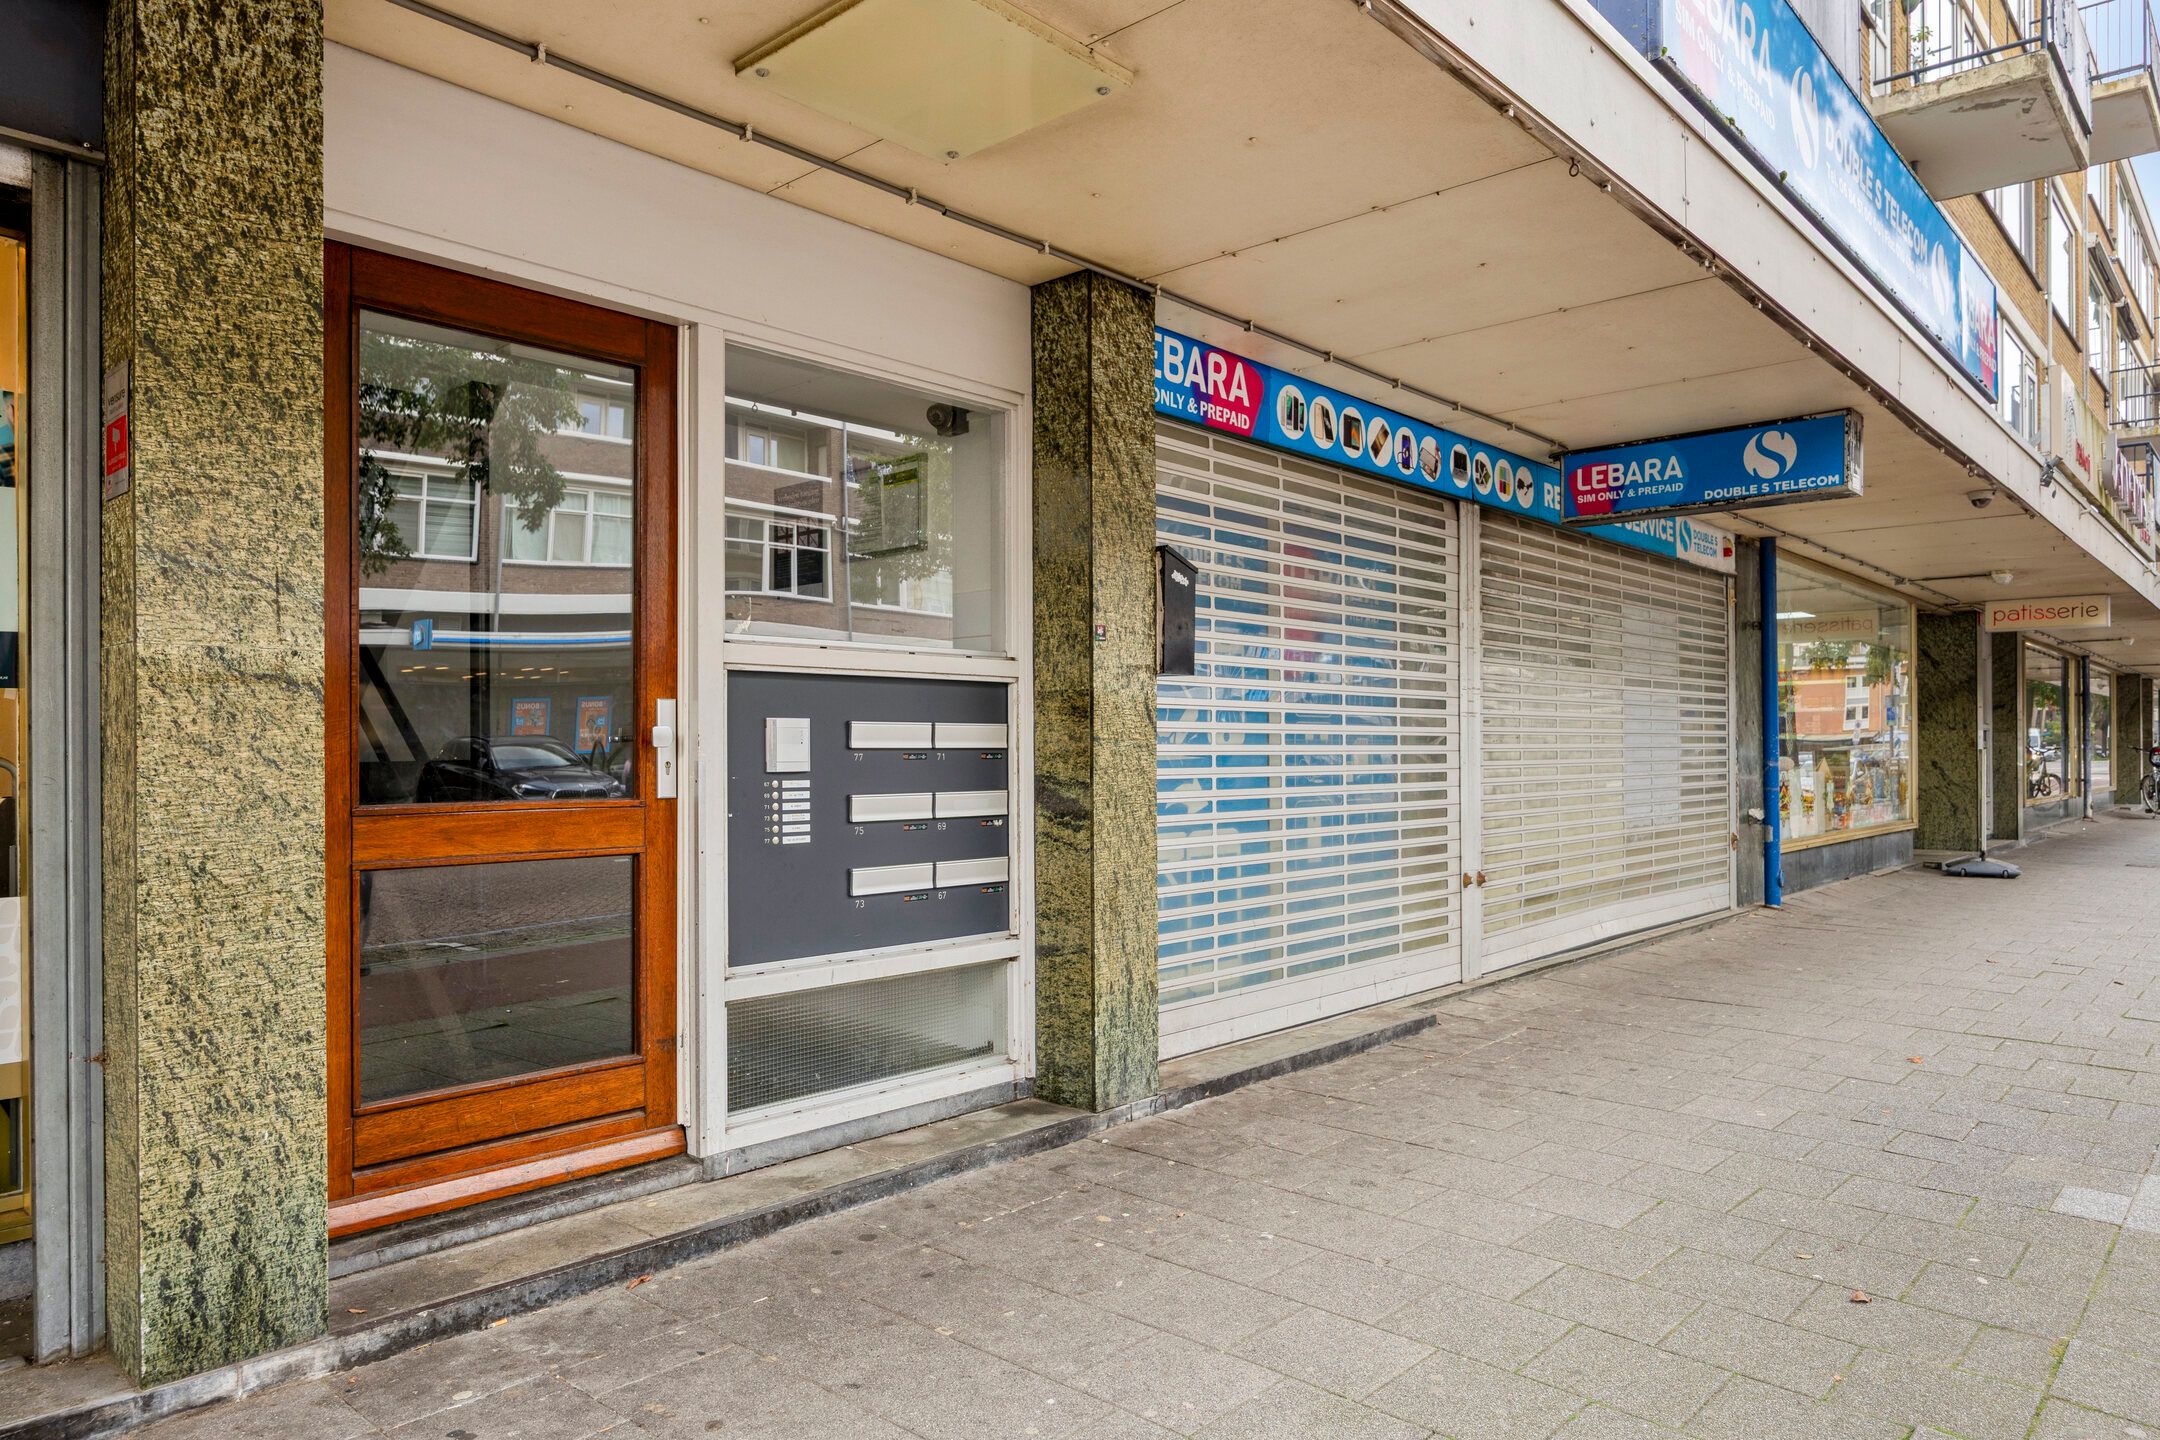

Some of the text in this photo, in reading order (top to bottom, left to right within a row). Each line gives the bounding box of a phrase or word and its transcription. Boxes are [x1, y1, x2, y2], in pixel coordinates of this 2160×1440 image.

[1825, 116, 1873, 201] DOUBLE
[1875, 179, 1883, 211] S
[1883, 188, 1928, 265] TELECOM
[1187, 397, 1199, 414] &
[1200, 400, 1250, 430] PREPAID
[1576, 455, 1683, 491] LEBARA
[1577, 482, 1684, 504] SIM ONLY & PREPAID
[1704, 474, 1840, 500] DOUBLE S TELECOM
[1693, 529, 1713, 545] DOUBLE
[1693, 542, 1718, 558] TELECOM
[1993, 602, 2099, 627] patisserie
[853, 753, 864, 761] 77
[936, 752, 945, 761] 71
[854, 826, 865, 835] 75
[937, 822, 947, 831] 69
[938, 890, 947, 900] 67
[855, 900, 865, 909] 73
